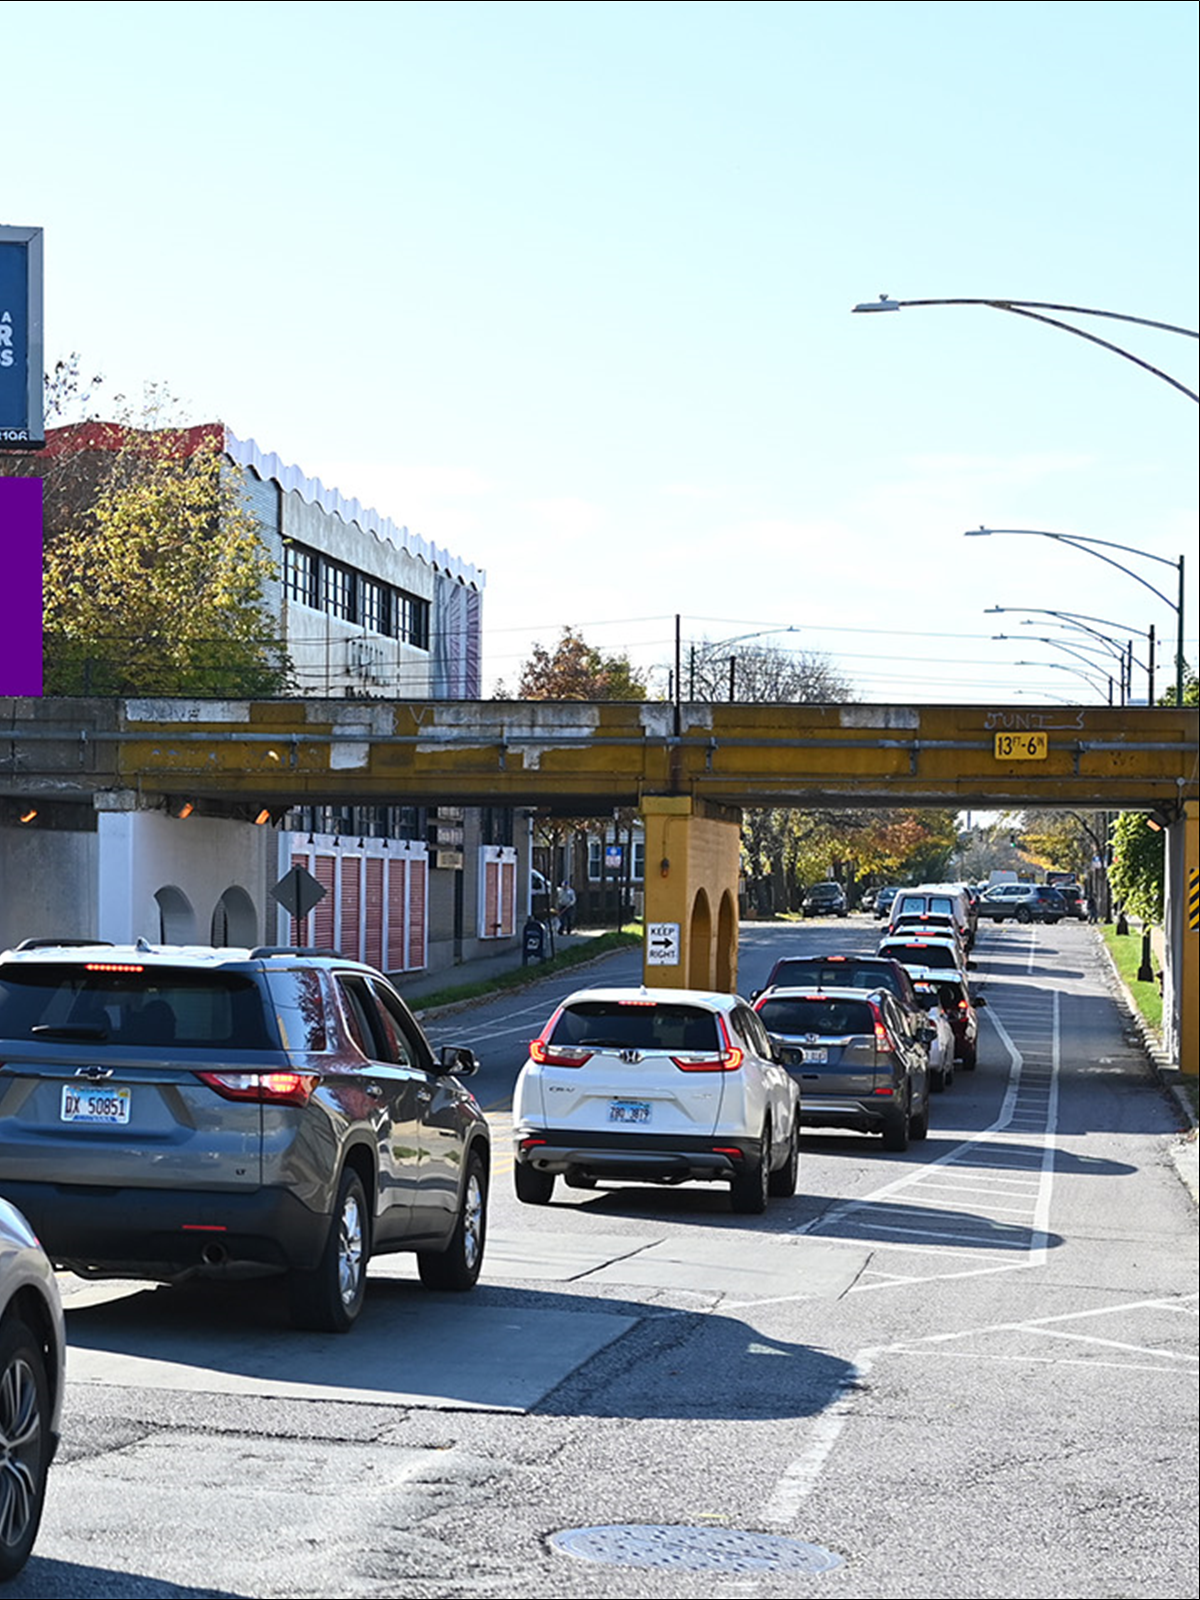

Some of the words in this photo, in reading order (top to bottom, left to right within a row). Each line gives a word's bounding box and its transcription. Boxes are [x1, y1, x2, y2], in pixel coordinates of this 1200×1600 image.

[1, 311, 12, 323] A
[650, 927, 675, 936] KEEP
[650, 950, 676, 959] RIGHT
[66, 1096, 80, 1114] DX
[88, 1097, 125, 1116] 50851
